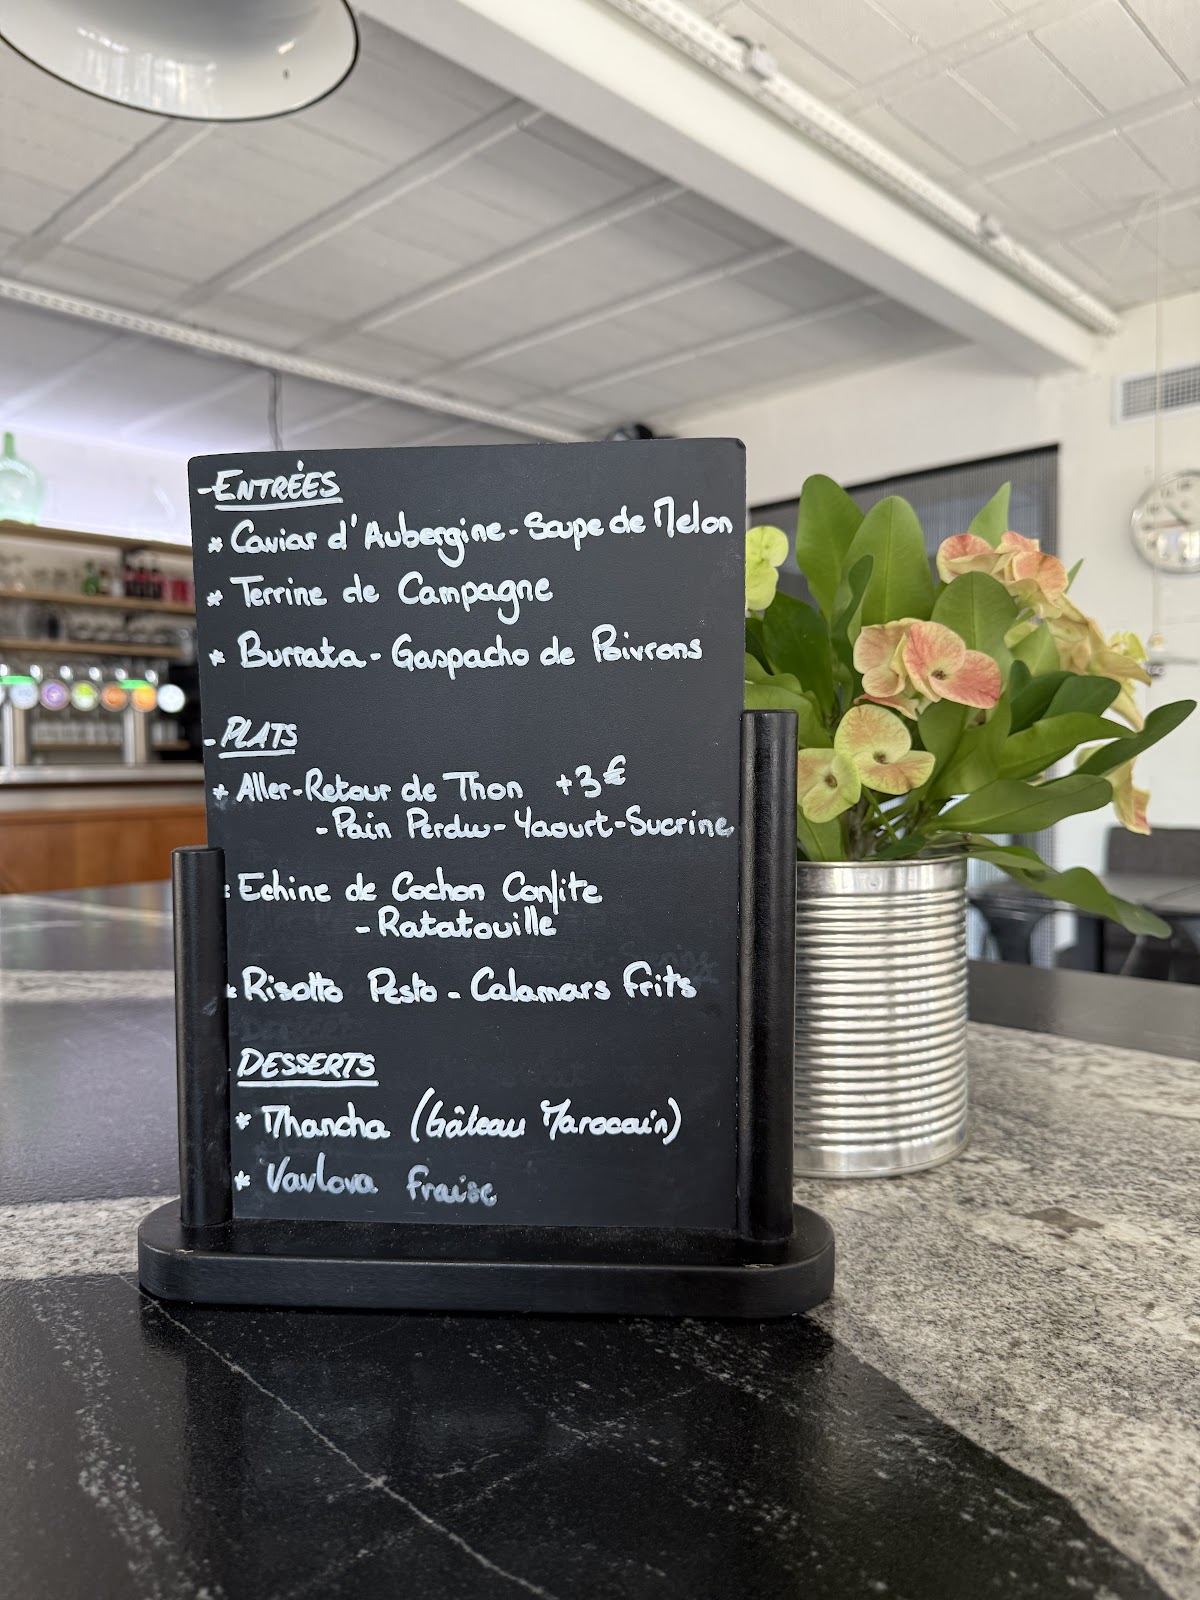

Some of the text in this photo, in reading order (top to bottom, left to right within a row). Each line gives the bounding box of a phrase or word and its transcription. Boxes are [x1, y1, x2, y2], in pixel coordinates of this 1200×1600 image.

[231, 519, 318, 553] Caviar
[609, 505, 646, 534] de
[654, 496, 733, 538] Melon
[230, 571, 553, 625] Terrine de Campagne
[237, 630, 367, 668] Burrata
[392, 633, 529, 680] Gaspacho
[540, 635, 575, 666] de
[592, 624, 702, 663] Poivrons
[401, 773, 437, 802] de
[442, 771, 523, 801] Thon
[332, 806, 392, 840] Pain
[238, 866, 603, 915] Echine de Cochon Confite
[378, 904, 557, 939] Ratatouille
[242, 966, 343, 1003] Risotto
[367, 967, 437, 1004] Pesto
[471, 966, 611, 1003] Calamars
[237, 1048, 376, 1079] DESSERTS
